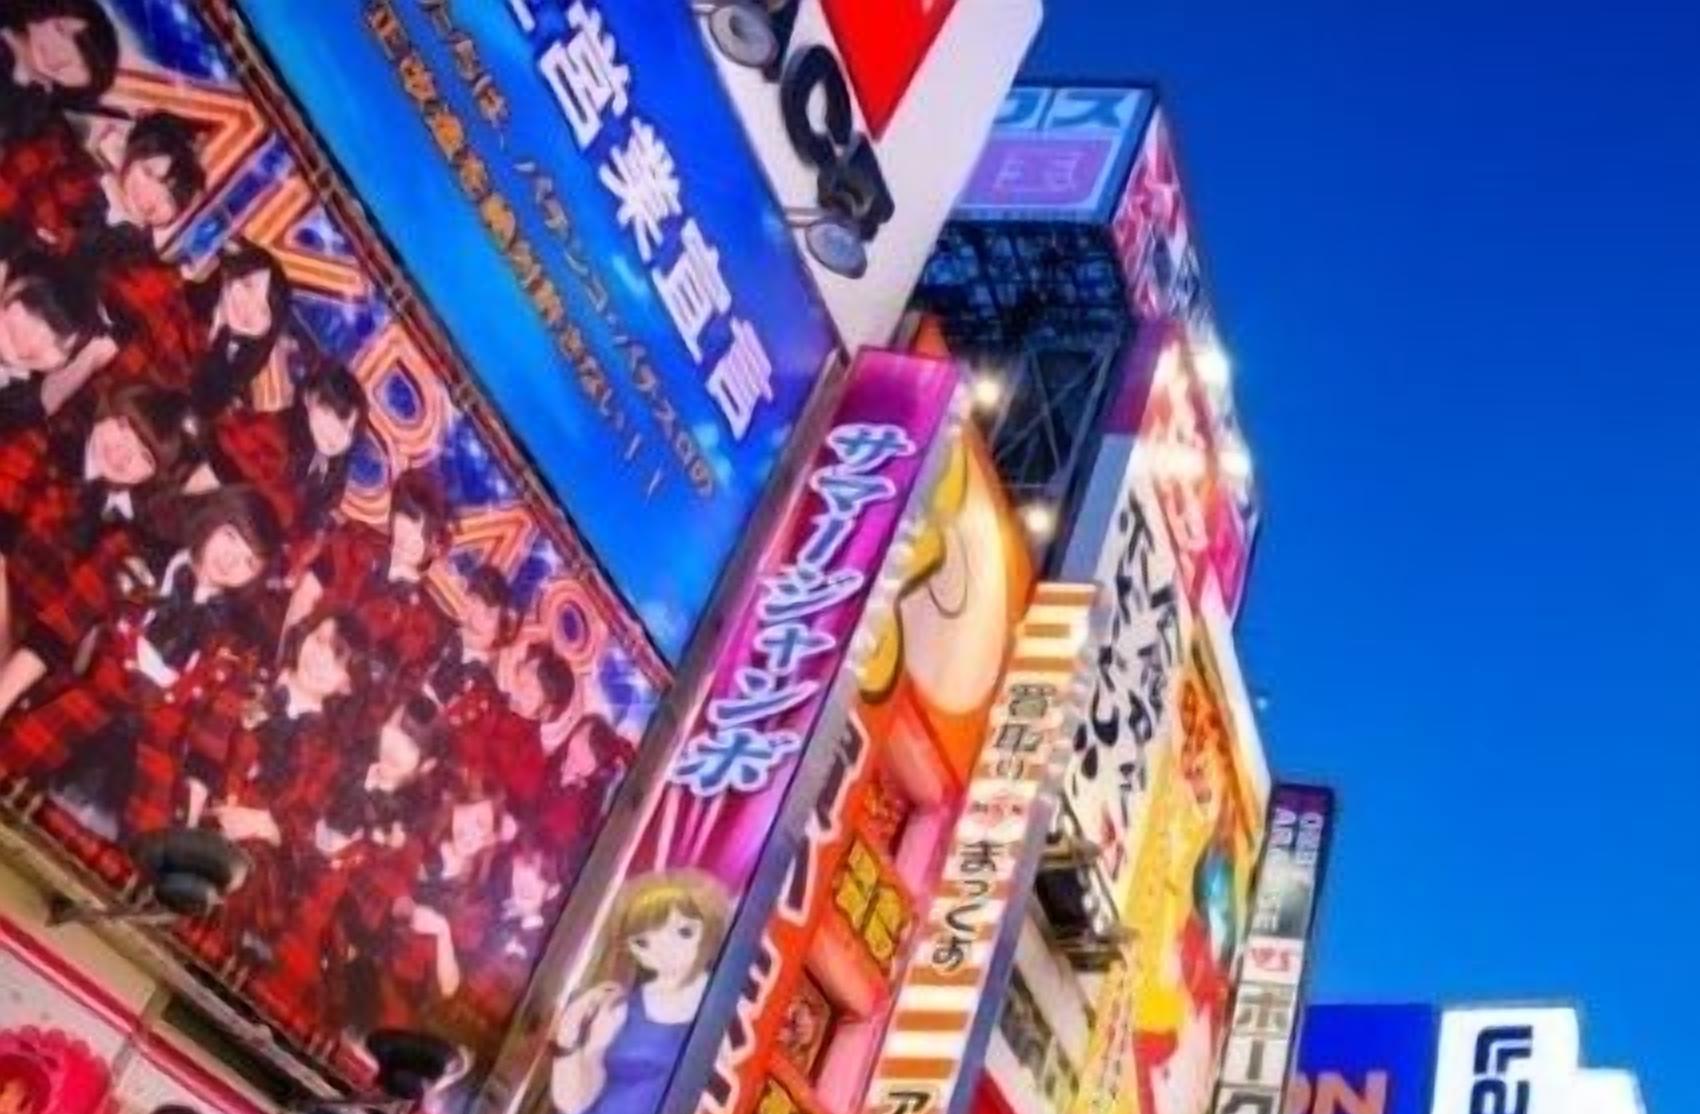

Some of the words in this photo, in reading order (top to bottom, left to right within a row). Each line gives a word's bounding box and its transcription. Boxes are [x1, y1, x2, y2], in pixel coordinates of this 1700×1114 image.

[675, 424, 916, 796] サマージャンボ
